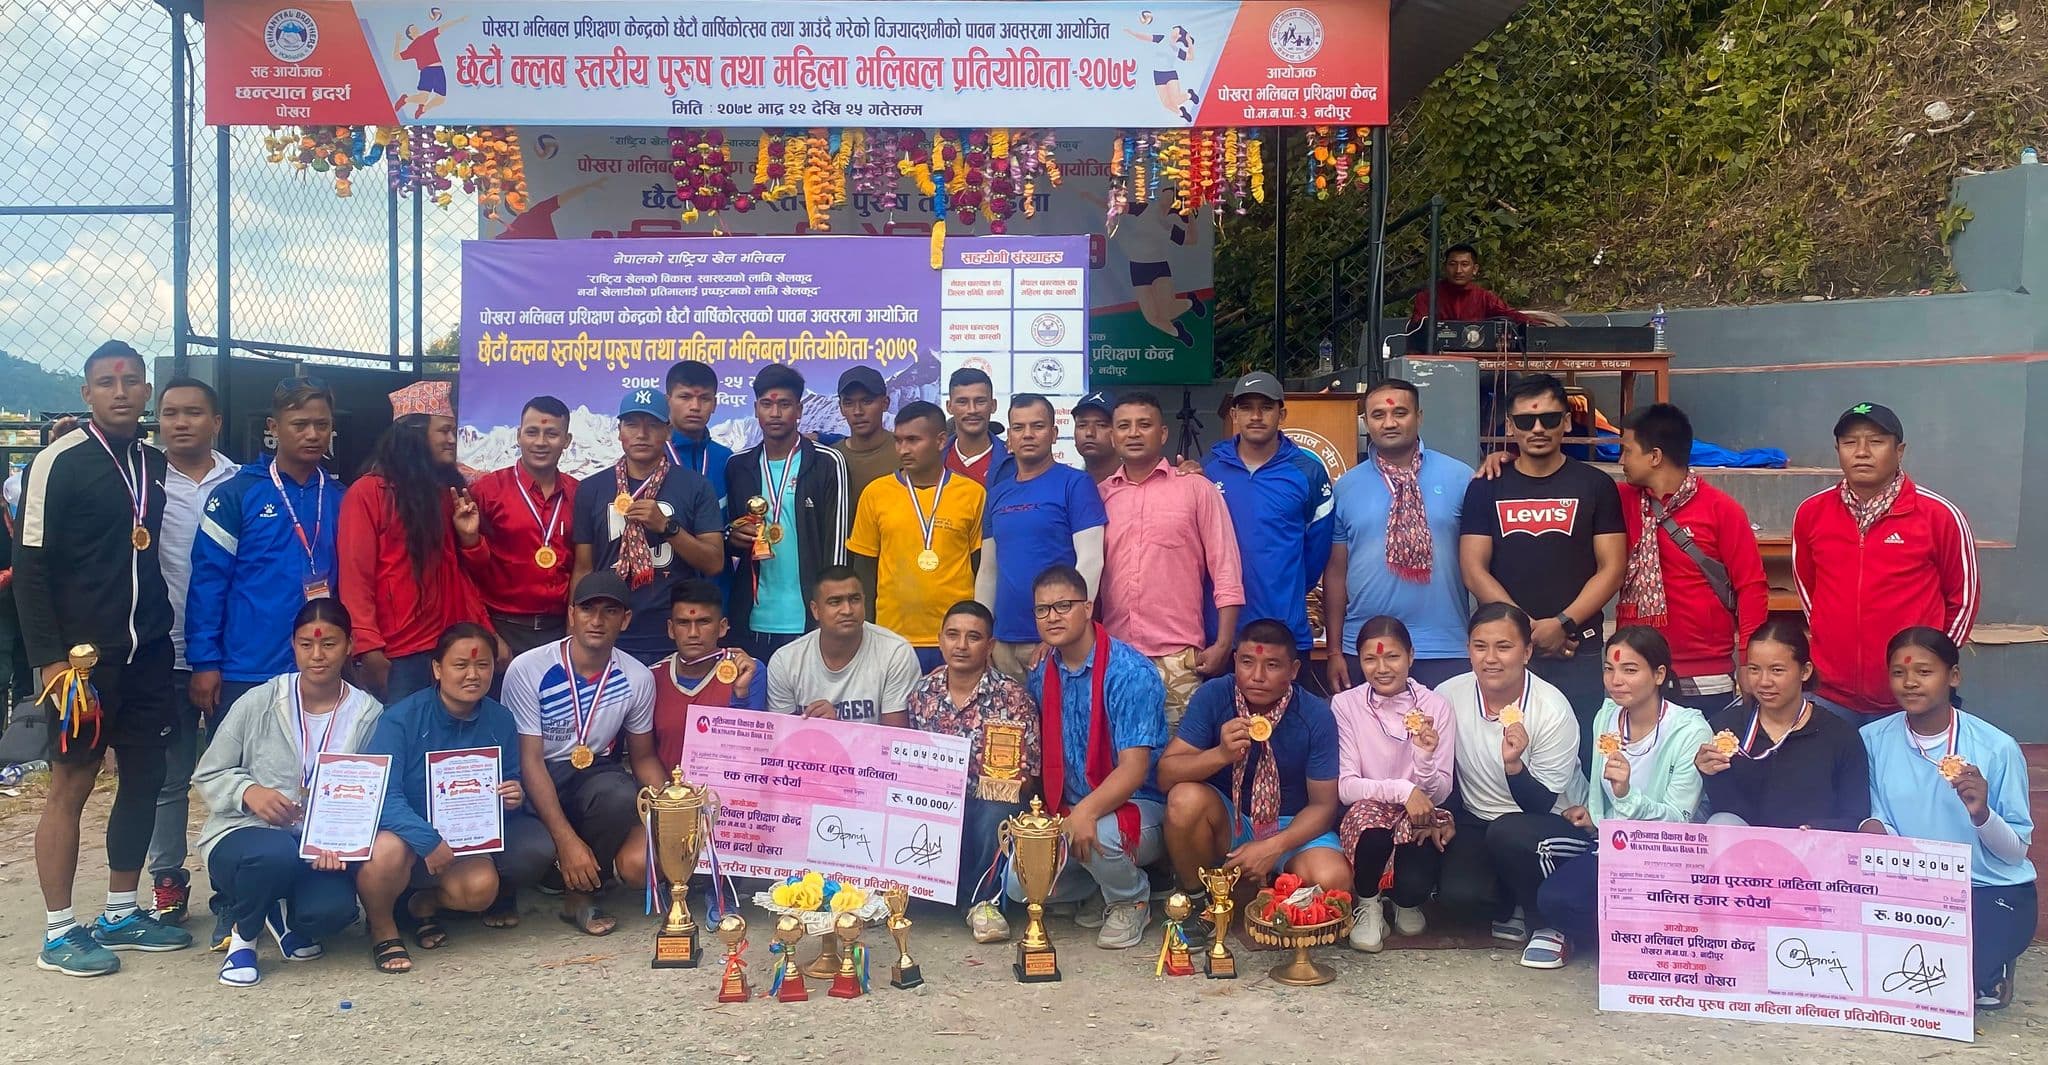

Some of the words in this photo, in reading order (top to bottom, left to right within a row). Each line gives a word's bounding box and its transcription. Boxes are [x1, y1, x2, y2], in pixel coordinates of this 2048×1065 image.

[482, 16, 518, 37] पोखरा
[523, 16, 569, 37] भलिबल
[573, 16, 620, 38] प्रशिक्षण
[624, 16, 669, 38] केन्द्रको
[702, 16, 766, 38] वार्षिकोत्सव
[771, 20, 794, 38] तथा
[835, 18, 870, 39] गरेको
[874, 17, 961, 39] विजयादशमीको
[966, 21, 995, 39] पावन
[1000, 21, 1053, 39] अवसरमा
[1056, 17, 1111, 40] आयोजित
[511, 54, 567, 89] क्लब
[574, 45, 650, 90] स्तरीय
[720, 54, 766, 89] तथा
[773, 45, 849, 90] महिला
[855, 45, 945, 90] भलिबल
[951, 45, 1138, 93] प्रतियोगिता-२०७९
[1266, 65, 1318, 79] आयोजक
[235, 85, 308, 101] छन्त्याल
[311, 83, 352, 102] ब्रदर्श
[1218, 84, 1253, 102] पोखरा
[1255, 83, 1300, 101] भलिबल
[1303, 83, 1347, 102] प्रशिक्षण
[1349, 82, 1378, 101] केन्द्र
[275, 103, 311, 119] पोखरा
[672, 100, 701, 115] मिति
[717, 102, 752, 115] २०७९
[758, 102, 785, 117] भाद्र
[788, 103, 807, 116] २२
[811, 99, 841, 117] देखि
[845, 103, 864, 117] २५
[868, 100, 923, 117] गतेसम्म
[1314, 105, 1353, 121] नदीपुर
[577, 154, 623, 174] पोखरा
[613, 251, 665, 265] नेपालको
[667, 251, 709, 268] राष्ट्रिय
[711, 250, 738, 264] खेल
[740, 250, 787, 264] भलिबल
[961, 250, 1009, 265] सहयोगी
[624, 272, 658, 284] खेलको
[748, 272, 773, 283] लागि
[600, 286, 647, 297] खेलाडीको
[753, 285, 779, 296] लागि
[479, 306, 515, 327] पोखरा
[519, 306, 566, 326] भलिबल
[568, 306, 615, 327] प्रशिक्षण
[617, 305, 663, 327] केन्द्रको
[693, 305, 773, 325] वार्षिकोत्सवको
[777, 307, 807, 324] पावन
[810, 307, 862, 324] अवसरमा
[865, 304, 920, 324] आयोजित
[510, 338, 550, 366] क्लब
[551, 331, 603, 372] स्तरीय
[644, 338, 676, 368] तथा
[678, 330, 727, 365] महिला
[729, 330, 788, 366] भलिबल
[788, 329, 919, 367] प्रतियोगिता-२०७९
[1092, 344, 1142, 362] प्रशिक्षण
[1144, 344, 1176, 362] केन्द्र
[1098, 365, 1128, 377] नदीपुर
[621, 376, 661, 389] २०७९
[760, 756, 784, 768] प्रथम
[787, 759, 828, 773] पुरस्कार
[723, 769, 741, 781] एक
[744, 772, 768, 786] लाख
[747, 809, 780, 824] प्रशिक्षण
[781, 812, 802, 827] केन्द्र
[1660, 831, 1683, 842] विकास
[757, 842, 784, 856] पोखरा
[1680, 845, 1696, 854] BANK
[773, 867, 792, 878] तथा
[1690, 873, 1720, 885] प्रथम
[1725, 875, 1774, 889] पुरस्कार
[1825, 879, 1880, 896] भलिबल)
[1646, 888, 1690, 905] चालिस
[1693, 894, 1730, 908] हजार
[1663, 922, 1700, 933] आयोजक
[1611, 930, 1642, 944] पोखरा
[1644, 932, 1685, 947] भलिबल
[1687, 934, 1728, 950] प्रशिक्षण
[1730, 937, 1757, 953] केन्द्र
[1640, 946, 1663, 956] पोखरा
[1627, 970, 1672, 983] छन्त्याल
[1704, 973, 1737, 988] पोखरा
[1628, 994, 1655, 1005] क्लब
[1658, 994, 1695, 1009] स्तरीय
[1728, 1001, 1751, 1013] तथा
[1754, 1000, 1792, 1016] महिला
[1795, 1003, 1841, 1020] भलिबल
[1844, 1006, 1942, 1032] प्रतियोगिता-२०७९
